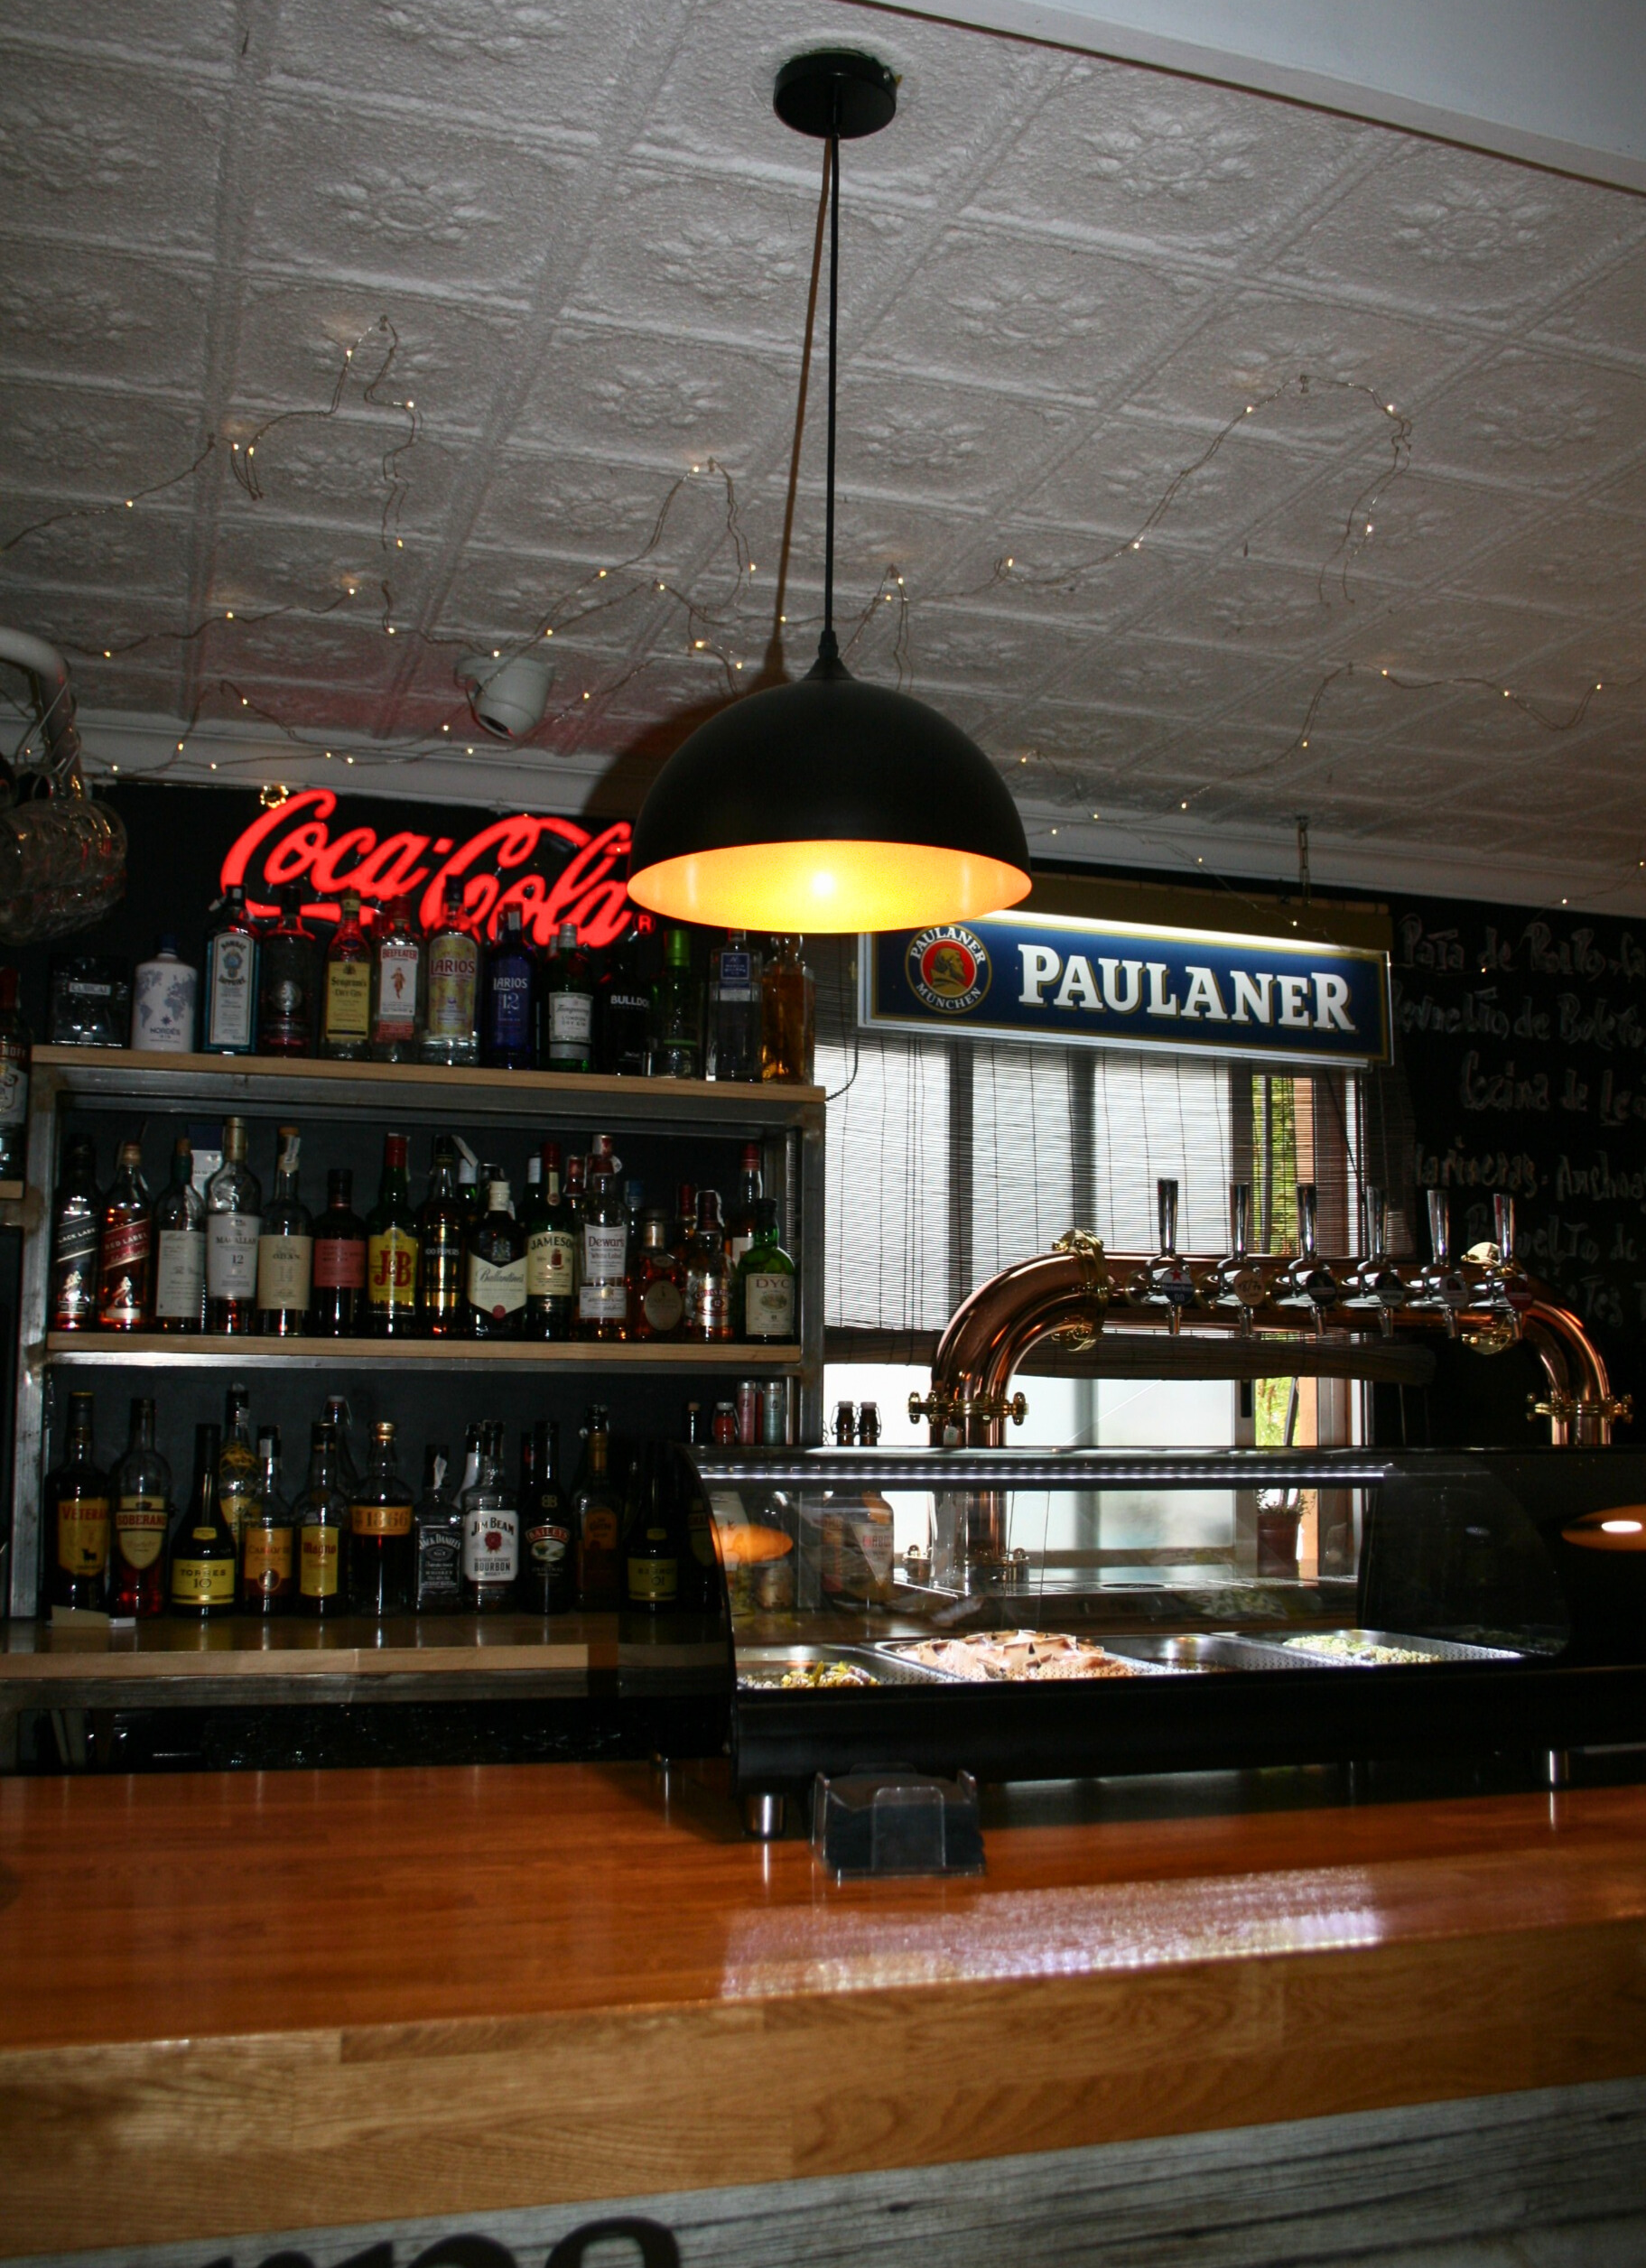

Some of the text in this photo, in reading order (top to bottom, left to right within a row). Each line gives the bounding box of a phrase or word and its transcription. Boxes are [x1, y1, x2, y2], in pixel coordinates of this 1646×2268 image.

[910, 926, 986, 965] PAULANER
[383, 949, 417, 961] BEEFEATER
[430, 960, 475, 976] LARIOS
[493, 978, 528, 990] LARIOS
[1018, 943, 1357, 1032] PAULANER
[502, 993, 519, 1009] 12
[58, 1233, 78, 1243] LACK
[105, 1232, 148, 1250] RED LABEL
[531, 1236, 572, 1250] JAMESO
[232, 1254, 244, 1264] 12
[756, 1278, 790, 1288] DYC
[61, 1507, 107, 1520] VETERA
[471, 1517, 515, 1536] JIM BEAM
[528, 1527, 569, 1539] BAILEYS
[418, 1536, 436, 1550] JACK
[181, 1568, 226, 1576] TORRES
[474, 1562, 511, 1572] BOURBON
[193, 1580, 212, 1589] 10
